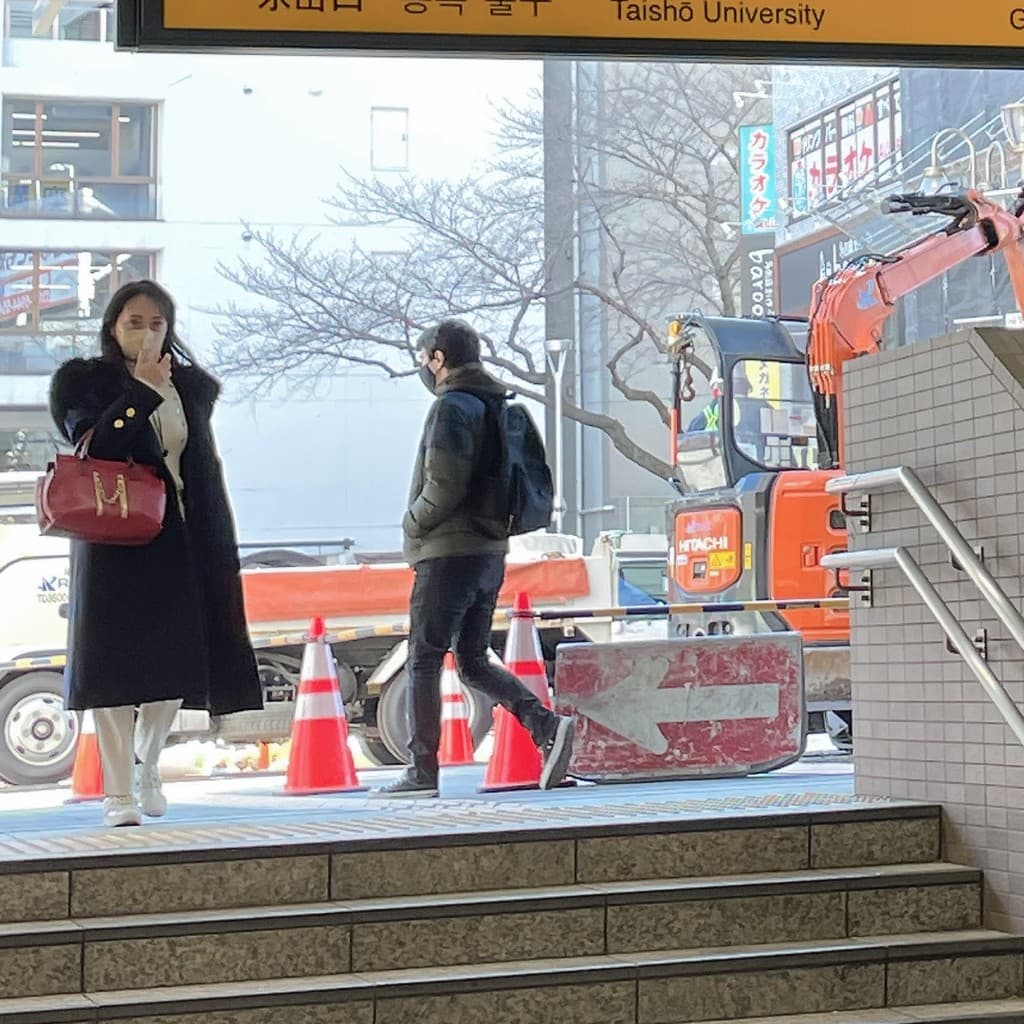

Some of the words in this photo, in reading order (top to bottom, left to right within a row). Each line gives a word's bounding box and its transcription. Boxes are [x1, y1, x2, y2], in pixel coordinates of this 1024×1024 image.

[703, 0, 825, 31] University
[750, 130, 767, 216] カラオケ
[808, 141, 873, 198] カラオケ
[679, 536, 728, 552] HITACHI
